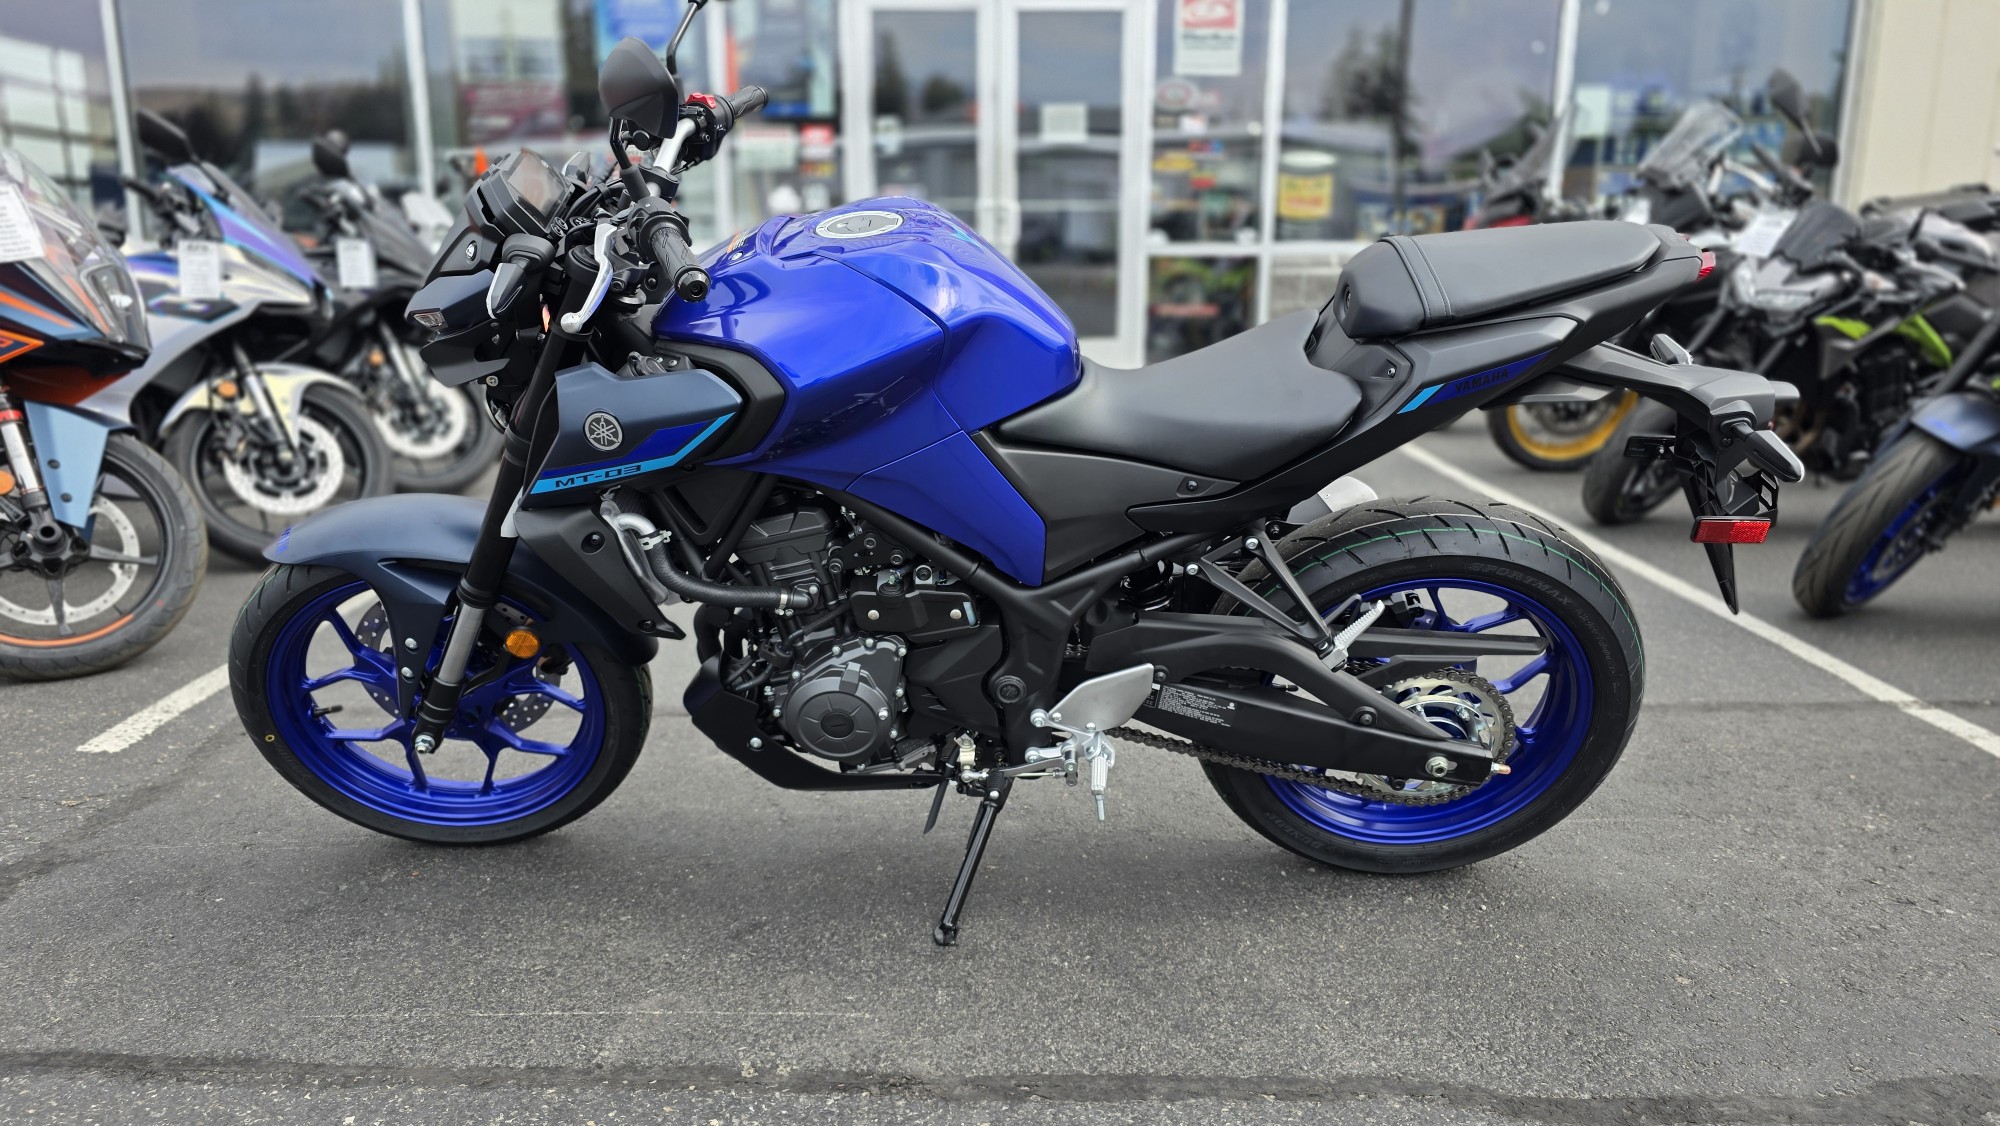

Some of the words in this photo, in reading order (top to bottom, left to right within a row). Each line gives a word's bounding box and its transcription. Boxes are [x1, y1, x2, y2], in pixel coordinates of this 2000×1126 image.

[1455, 368, 1509, 393] YAMAHA
[555, 464, 642, 488] MT-03
[1469, 562, 1573, 606] SPORTMAX
